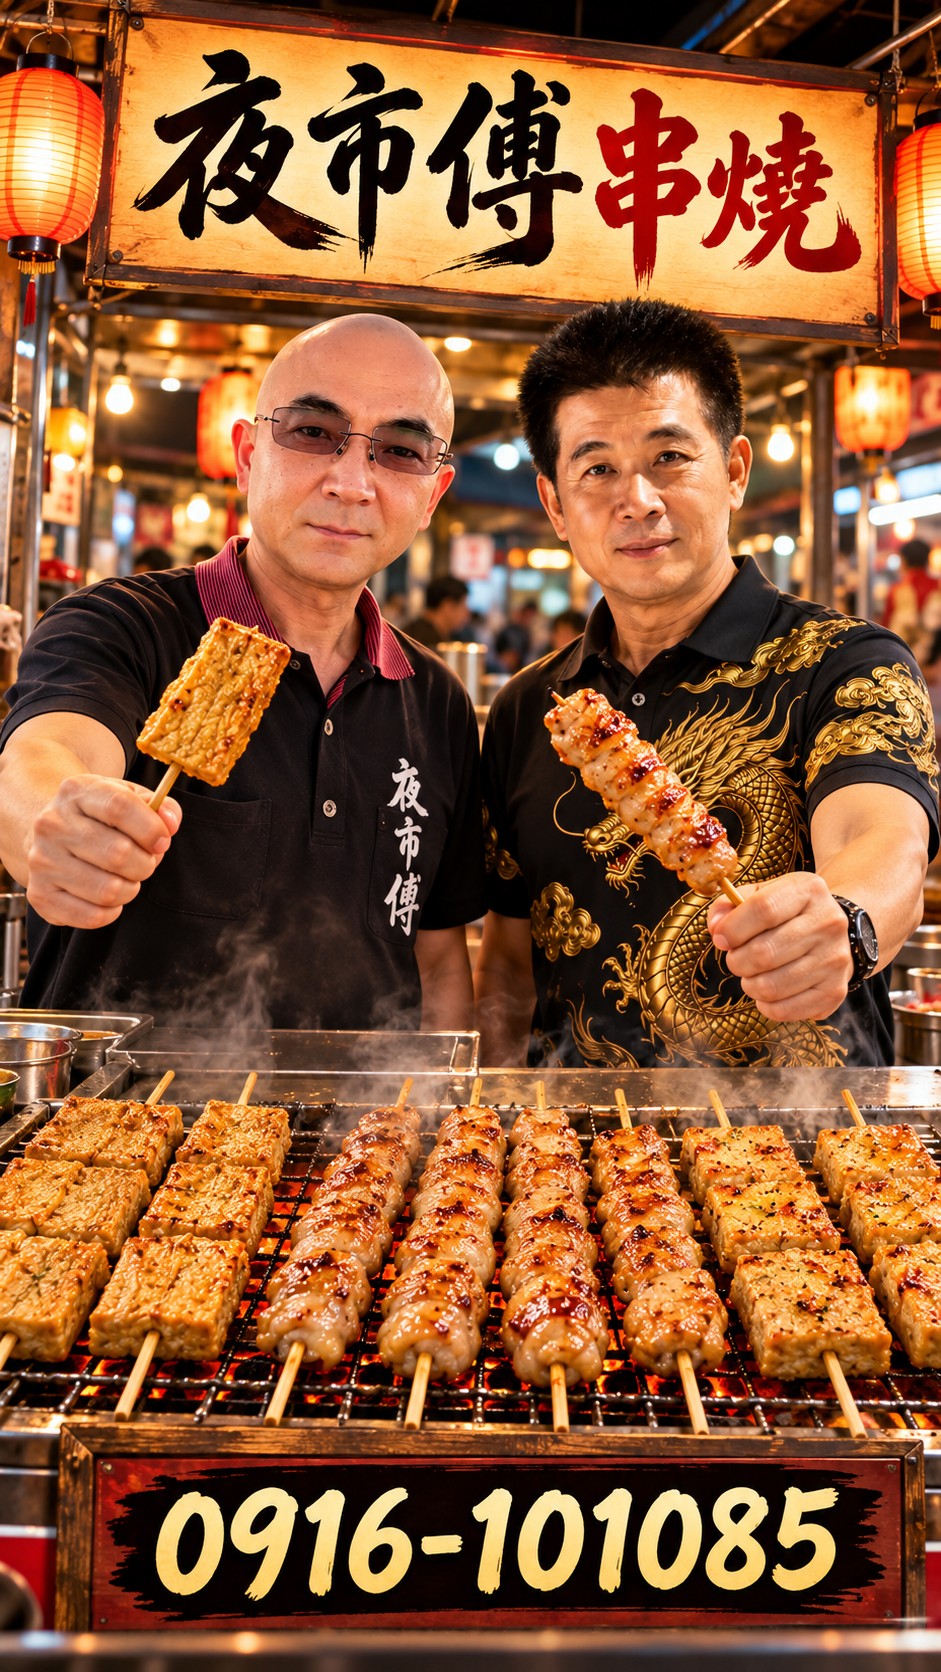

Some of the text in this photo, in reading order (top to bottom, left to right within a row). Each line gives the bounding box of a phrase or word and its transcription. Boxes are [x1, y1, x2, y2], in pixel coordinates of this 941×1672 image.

[132, 48, 862, 290] 夜市傅串燒
[384, 757, 429, 936] 夜市傅
[155, 1486, 839, 1601] 0916-101085
